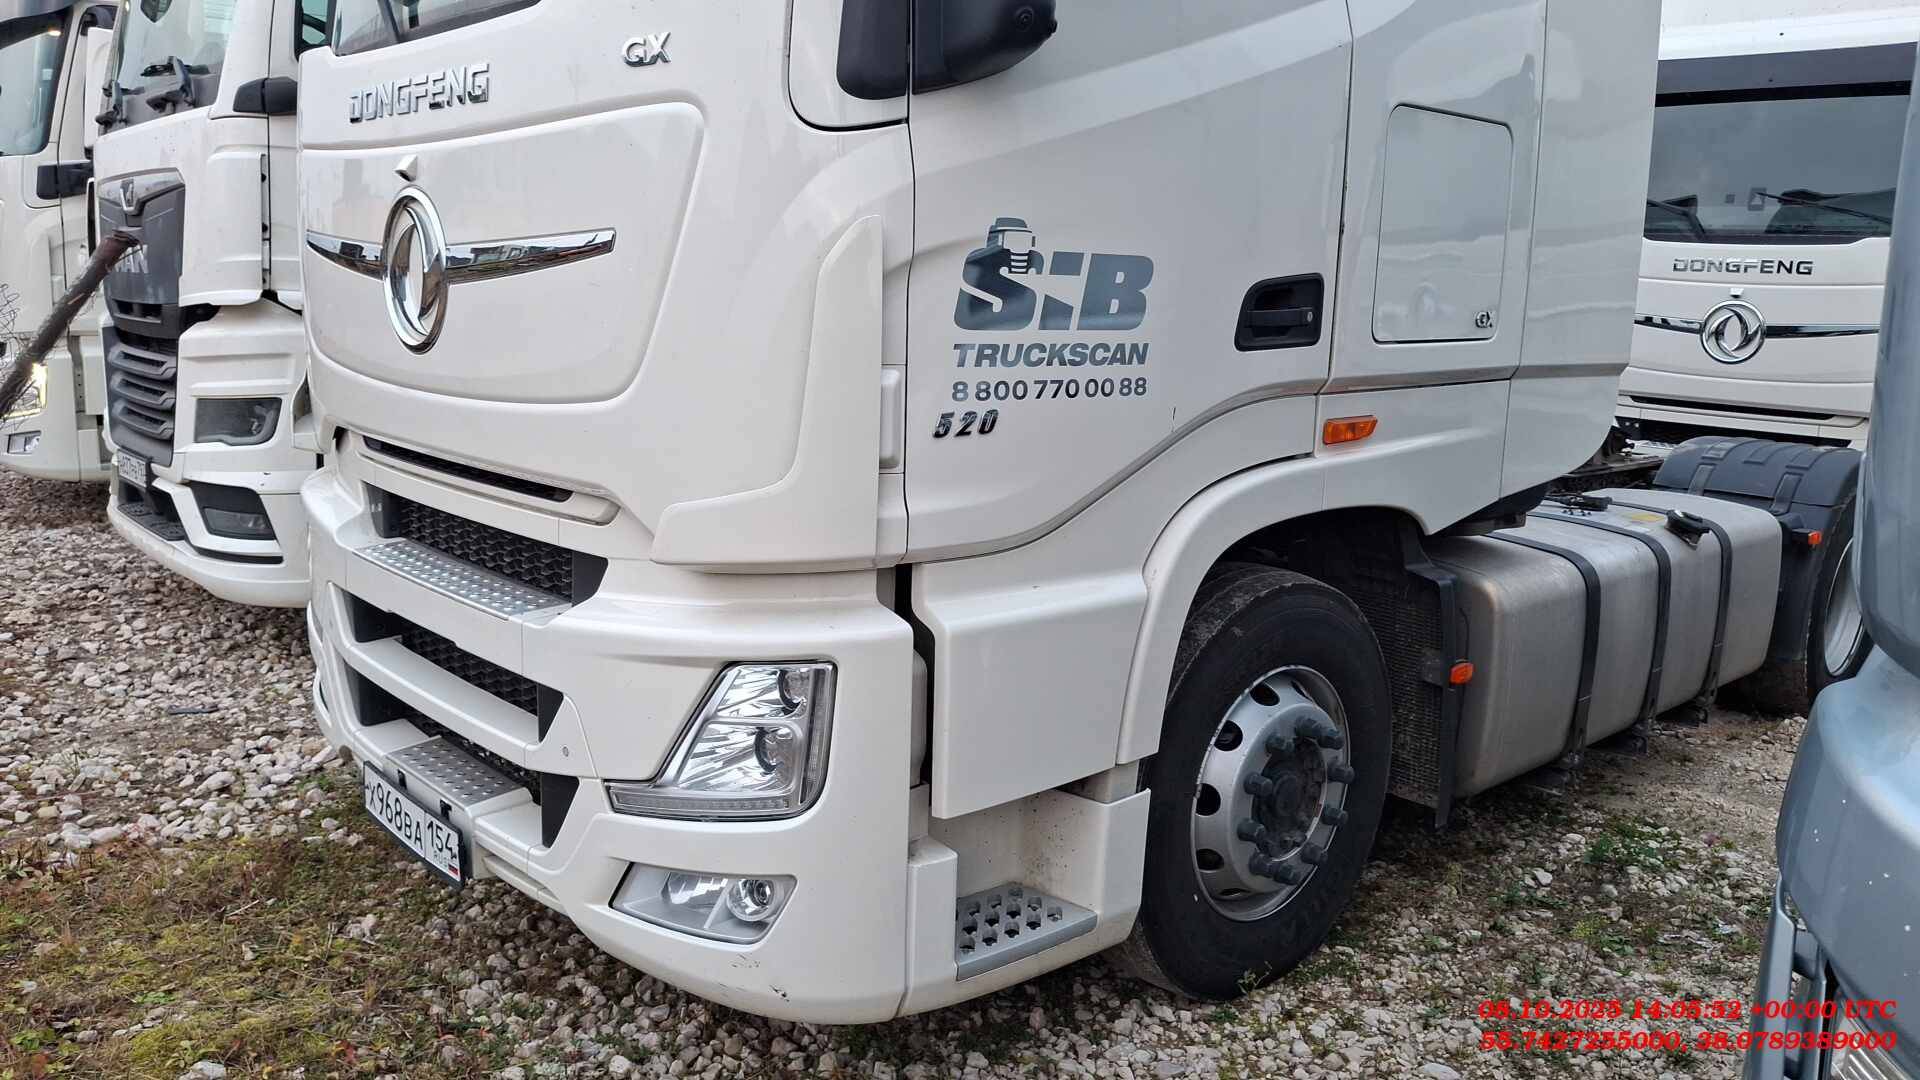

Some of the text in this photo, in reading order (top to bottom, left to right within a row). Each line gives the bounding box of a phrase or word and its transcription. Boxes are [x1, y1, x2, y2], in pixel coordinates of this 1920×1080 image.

[621, 31, 672, 68] GX
[349, 63, 490, 124] DONGFENG
[1672, 258, 1814, 276] DONGFENG
[953, 342, 1149, 368] TRUCKSCAN
[932, 408, 999, 439] 520
